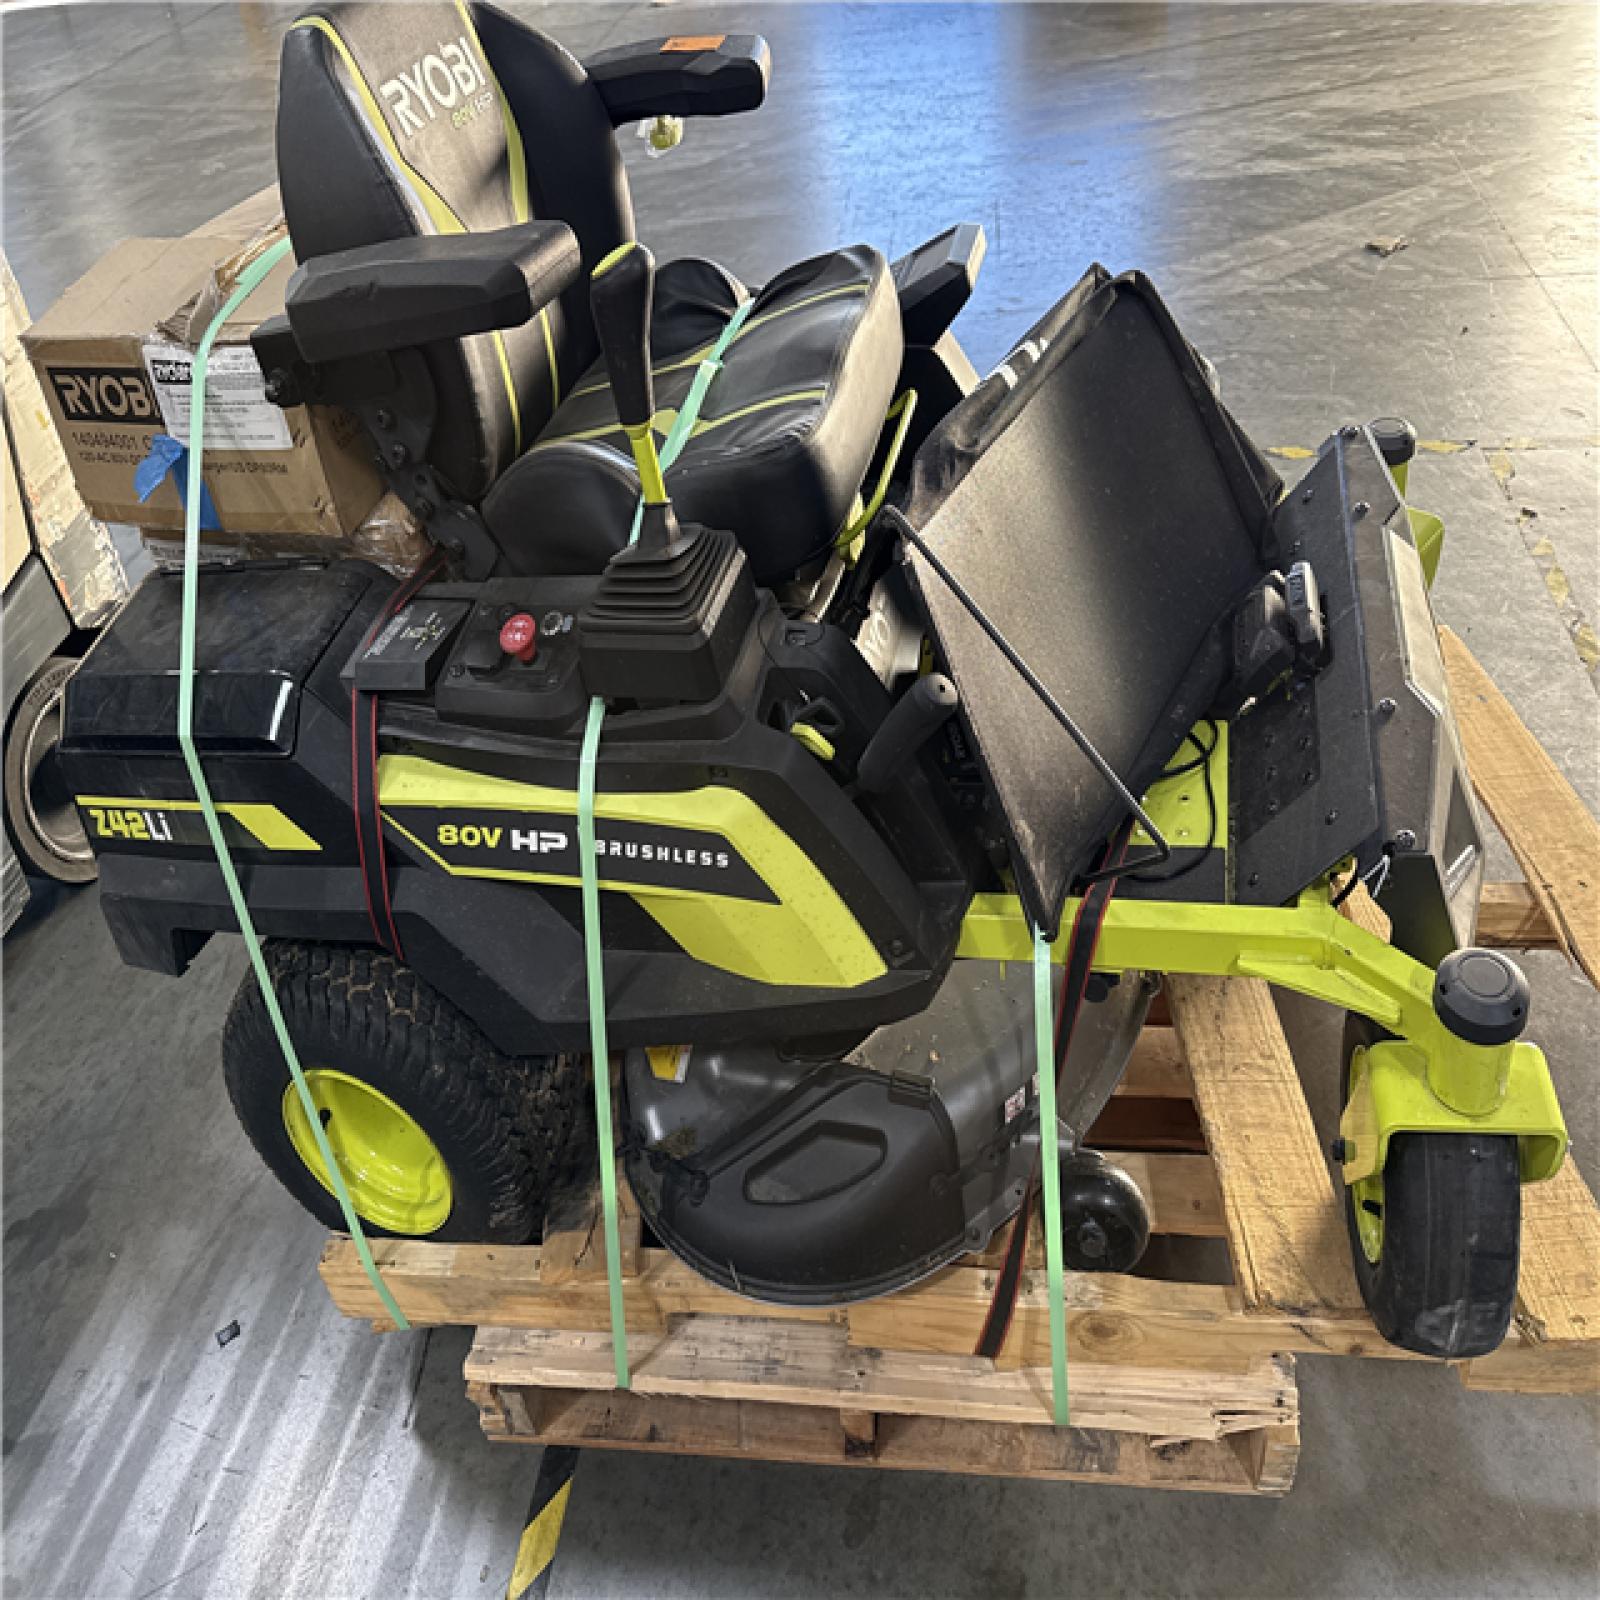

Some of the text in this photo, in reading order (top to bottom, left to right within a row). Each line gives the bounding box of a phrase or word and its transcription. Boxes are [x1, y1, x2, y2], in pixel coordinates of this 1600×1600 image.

[379, 36, 486, 137] RYOBI
[53, 373, 160, 417] RYOB
[88, 808, 174, 841] Z42Li
[436, 823, 730, 869] 80V HP BRUSHLESS
